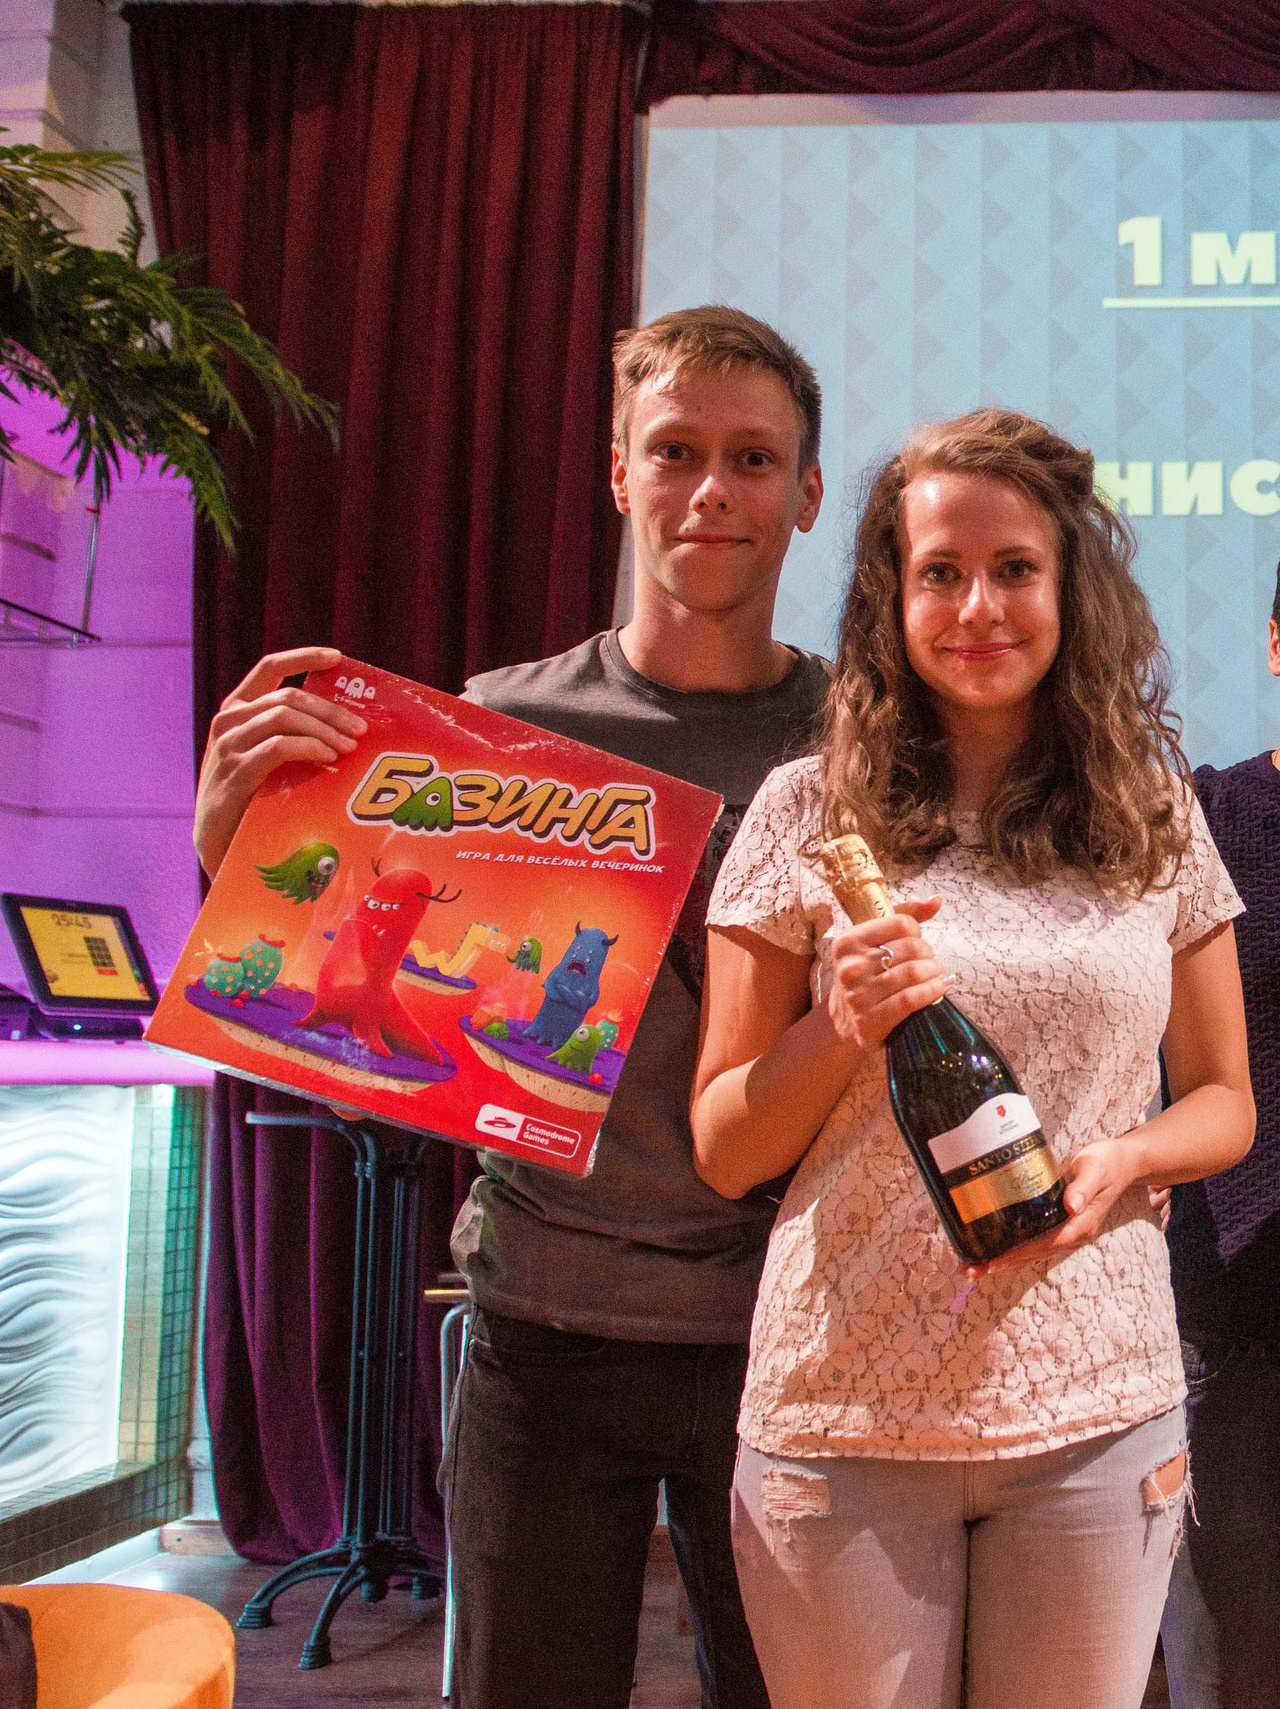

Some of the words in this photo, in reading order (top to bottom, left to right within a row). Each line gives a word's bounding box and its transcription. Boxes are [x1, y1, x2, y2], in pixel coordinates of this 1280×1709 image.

[1118, 216, 1161, 286] 1
[350, 754, 653, 858] БАЗИНГА
[455, 850, 491, 861] ИГРА
[493, 853, 524, 864] ДЛЯ
[526, 855, 588, 868] ВЕСЁЛЫХ
[590, 860, 665, 874] ВЕЧЕРИНОК
[522, 1131, 549, 1145] Games
[525, 1123, 575, 1145] Cosmodrome
[968, 1147, 1013, 1176] SANTO
